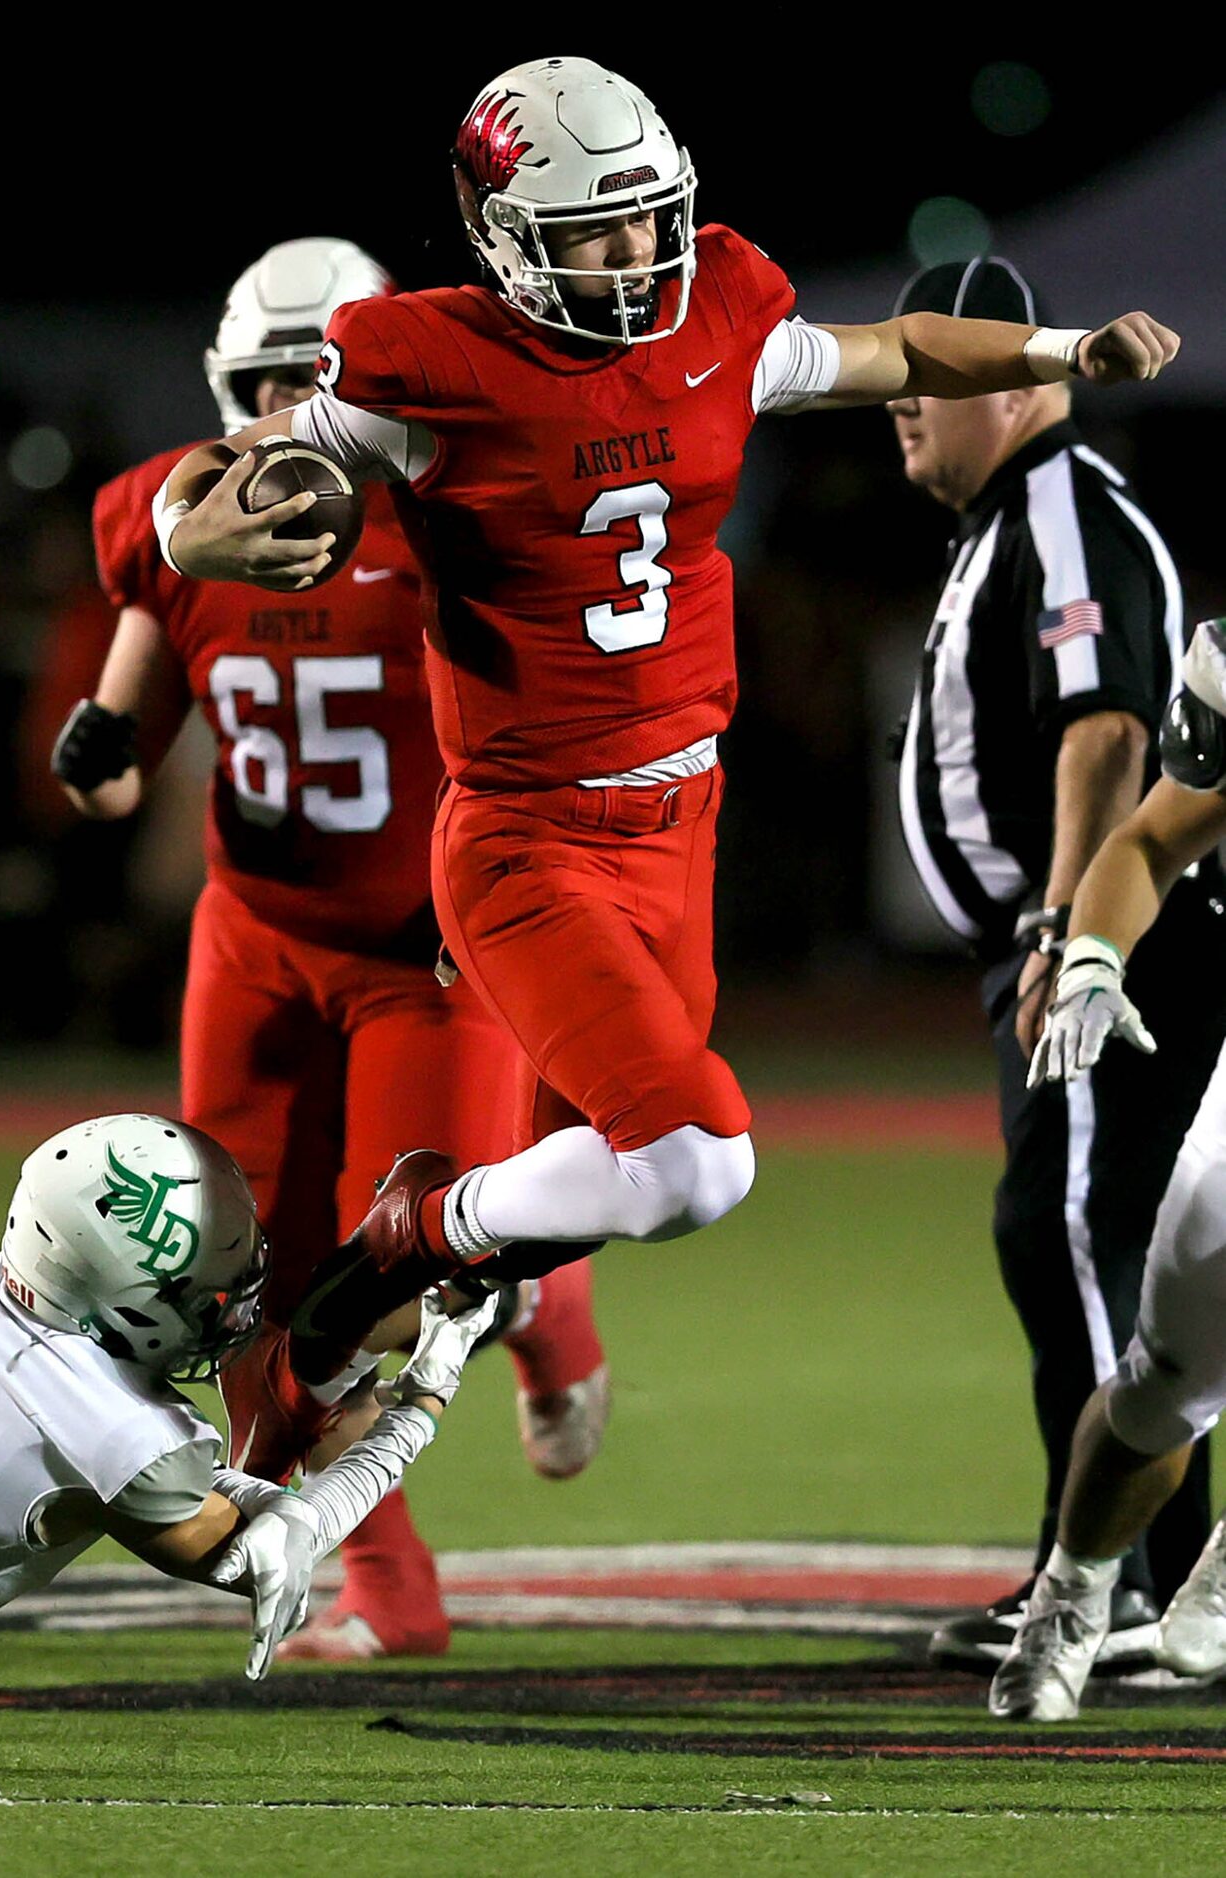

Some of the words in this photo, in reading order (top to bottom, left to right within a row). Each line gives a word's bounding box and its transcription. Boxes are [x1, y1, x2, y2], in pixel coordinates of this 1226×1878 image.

[574, 426, 675, 480] ARGYLE
[579, 479, 674, 654] 3
[208, 655, 393, 832] 65
